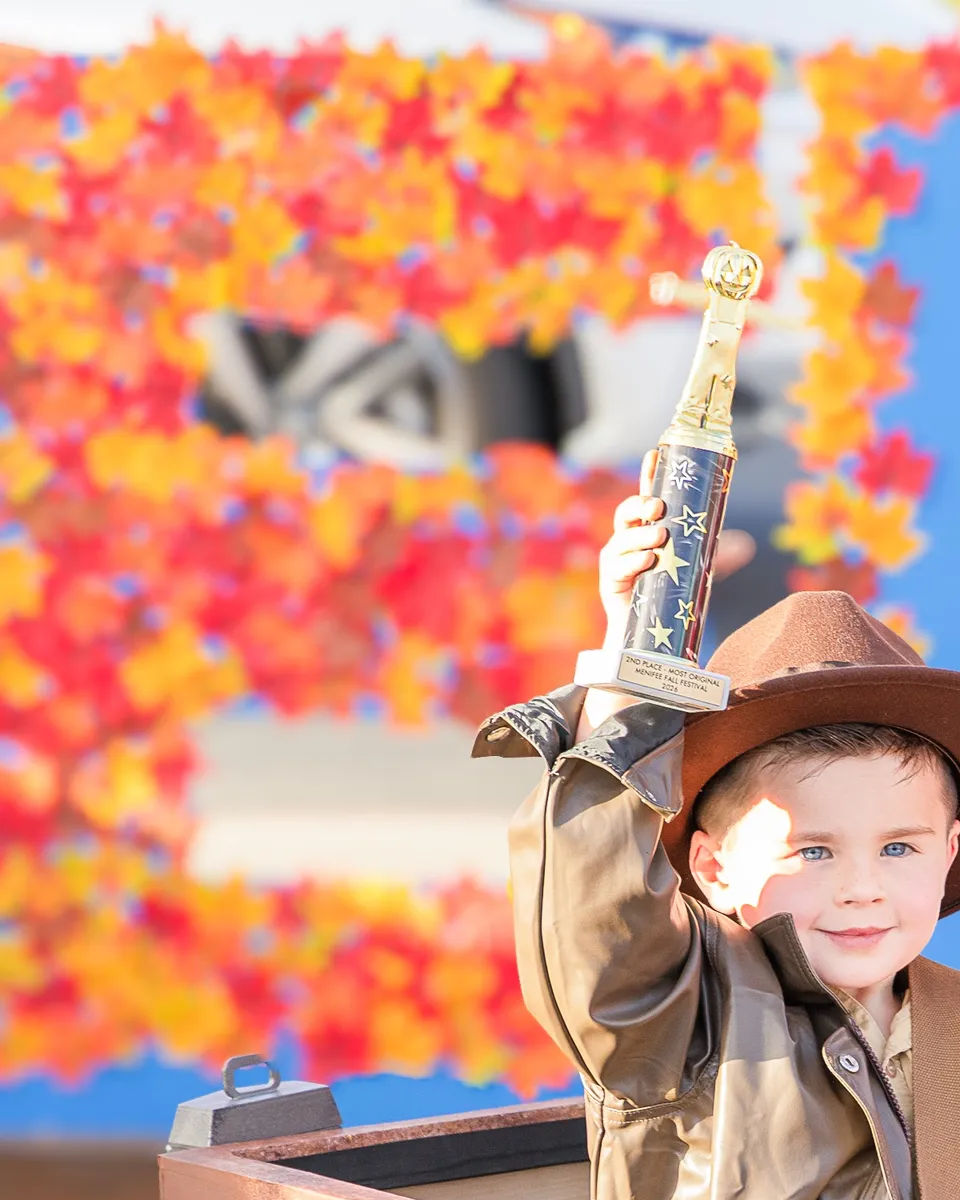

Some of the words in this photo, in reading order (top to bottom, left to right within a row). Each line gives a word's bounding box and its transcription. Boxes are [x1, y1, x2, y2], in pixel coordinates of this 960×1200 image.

[626, 656, 641, 665] 2ND
[642, 660, 662, 671] PLACE
[668, 668, 688, 678] MOST
[689, 673, 720, 687] ORIGINAL
[635, 668, 663, 680] MENIFEE
[664, 675, 679, 684] FALL
[680, 679, 708, 692] FESTIVAL
